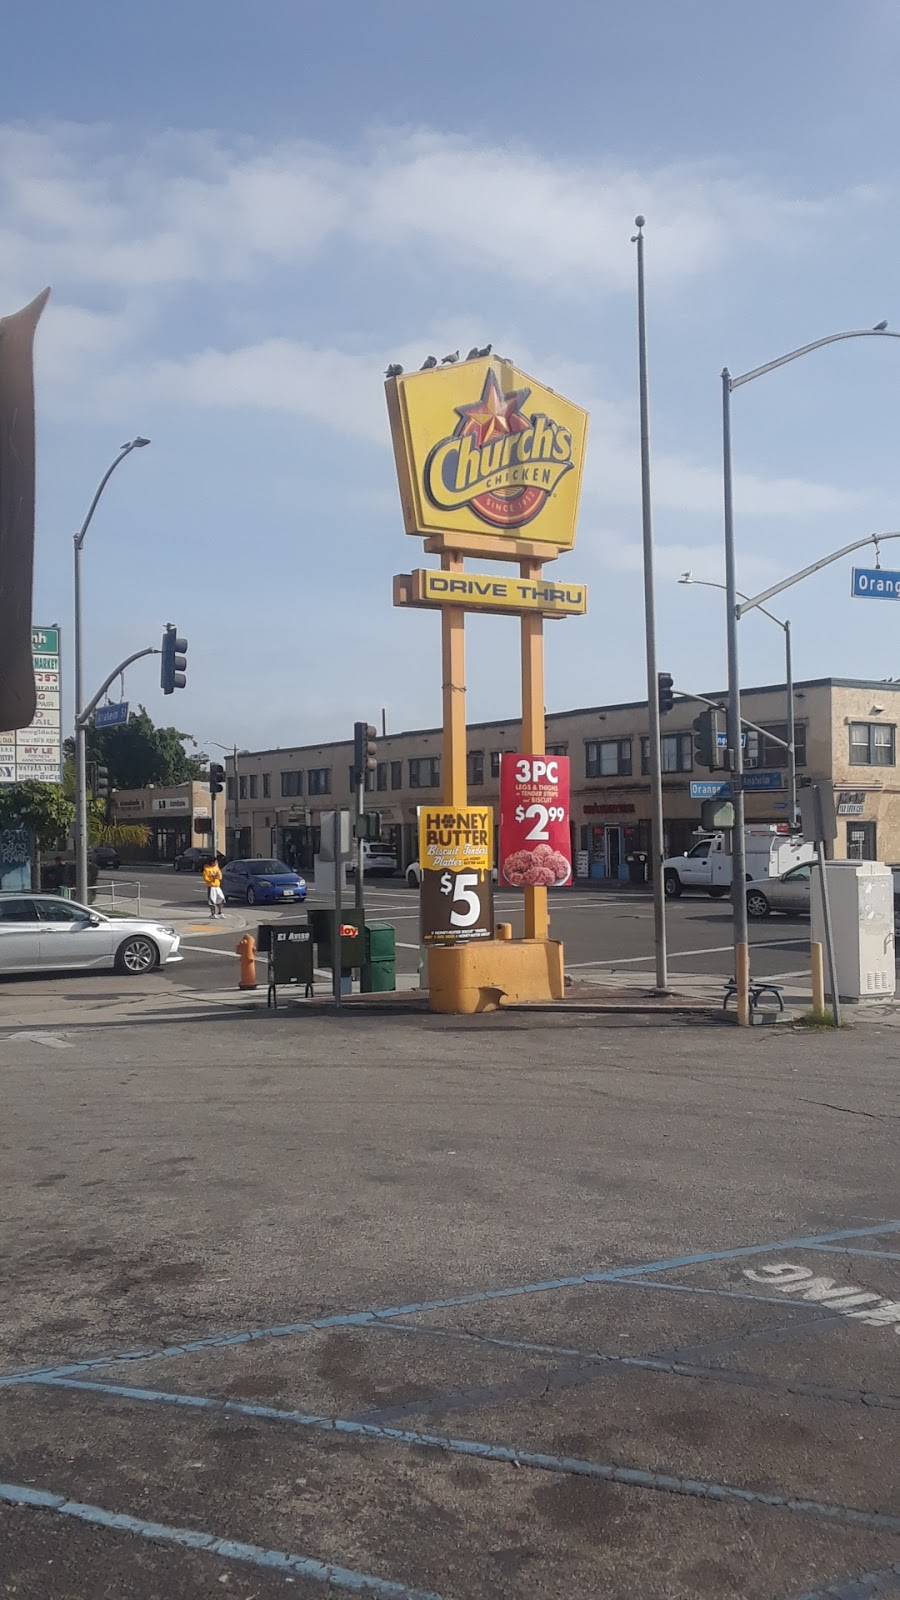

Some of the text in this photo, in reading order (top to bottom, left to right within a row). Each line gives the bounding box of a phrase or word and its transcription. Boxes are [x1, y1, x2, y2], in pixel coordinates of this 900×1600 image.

[424, 413, 572, 511] Church's
[486, 468, 551, 488] CHICKEN
[486, 498, 514, 512] SINCE
[429, 577, 583, 604] DRIVE THRU
[34, 656, 58, 670] MARKET
[515, 760, 558, 783] 3PC
[426, 813, 488, 830] HONEY
[426, 829, 488, 846] BUTTER
[427, 844, 459, 856] Biscuit
[440, 872, 481, 927] $5
[277, 932, 310, 941] El Aviso
